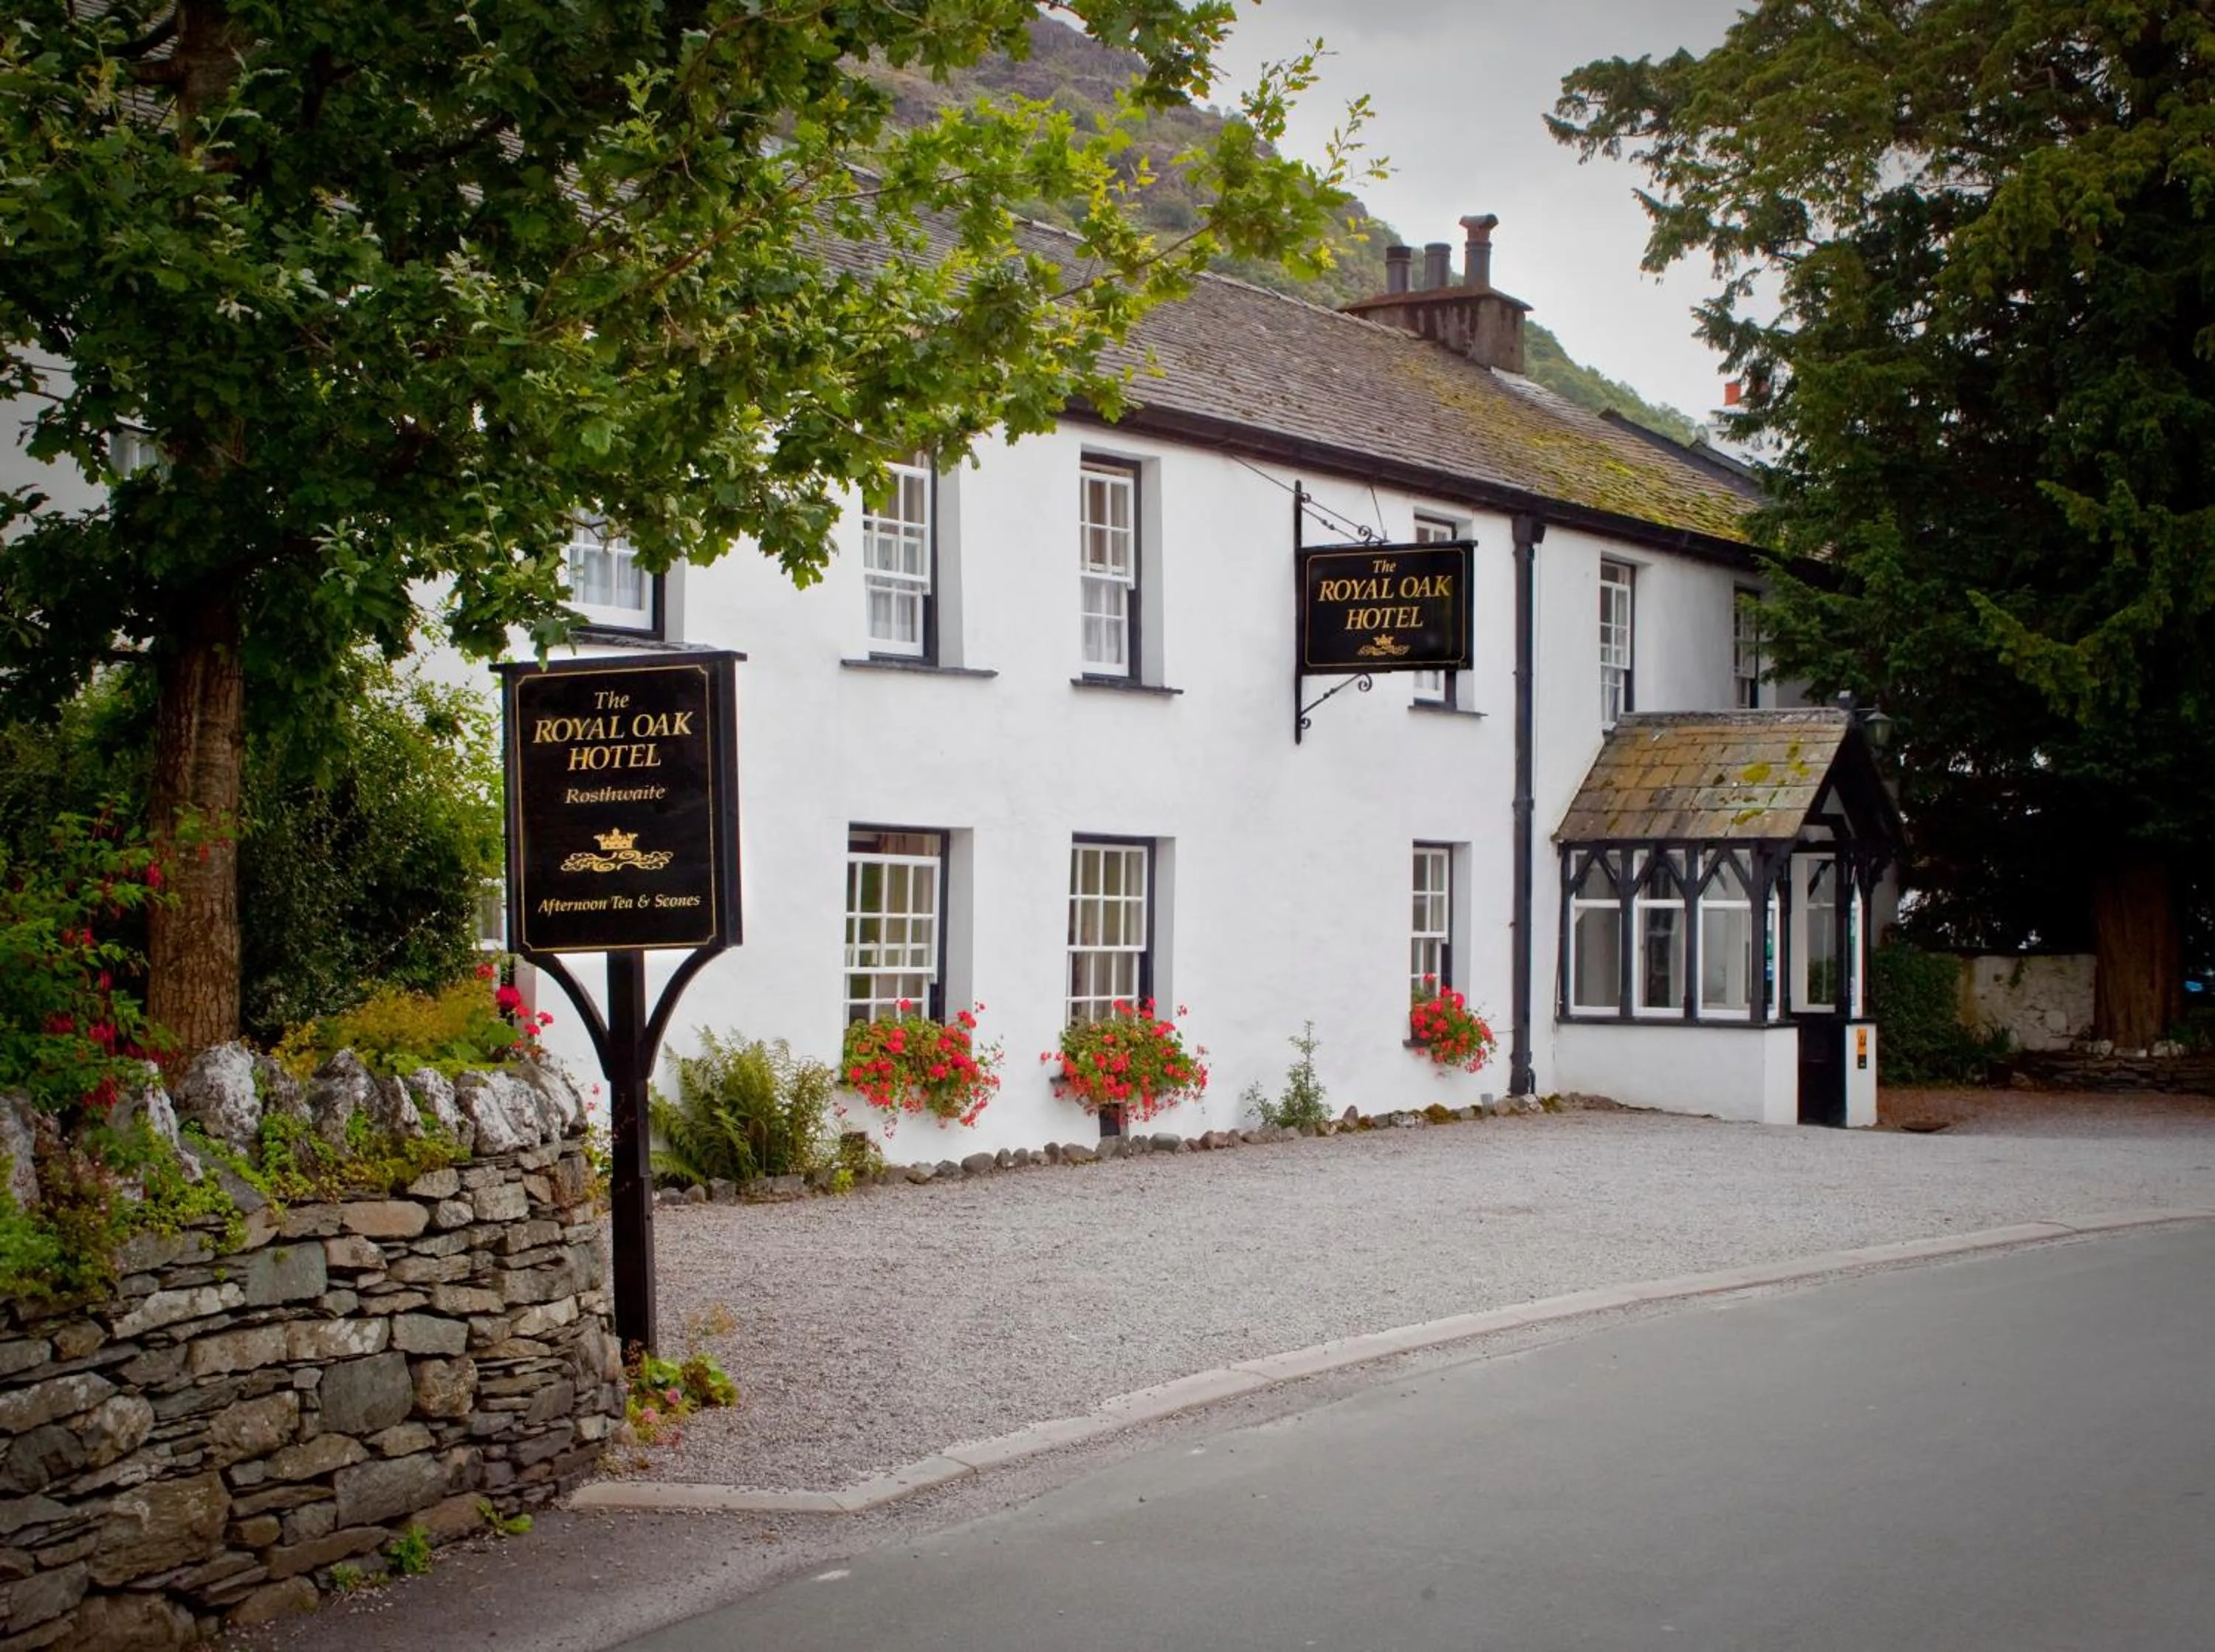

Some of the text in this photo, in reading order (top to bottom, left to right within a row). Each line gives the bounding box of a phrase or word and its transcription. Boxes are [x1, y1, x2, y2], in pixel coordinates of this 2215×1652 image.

[1373, 560, 1396, 574] The
[1318, 575, 1452, 602] ROYAL OAK
[1345, 606, 1423, 630] HOTEL
[594, 690, 630, 709] The
[532, 711, 693, 743] ROYAL OAK
[567, 743, 662, 771] HOTEL
[565, 785, 666, 804] Rosthwaite
[538, 893, 700, 916] Afternoon Tea & Scones
